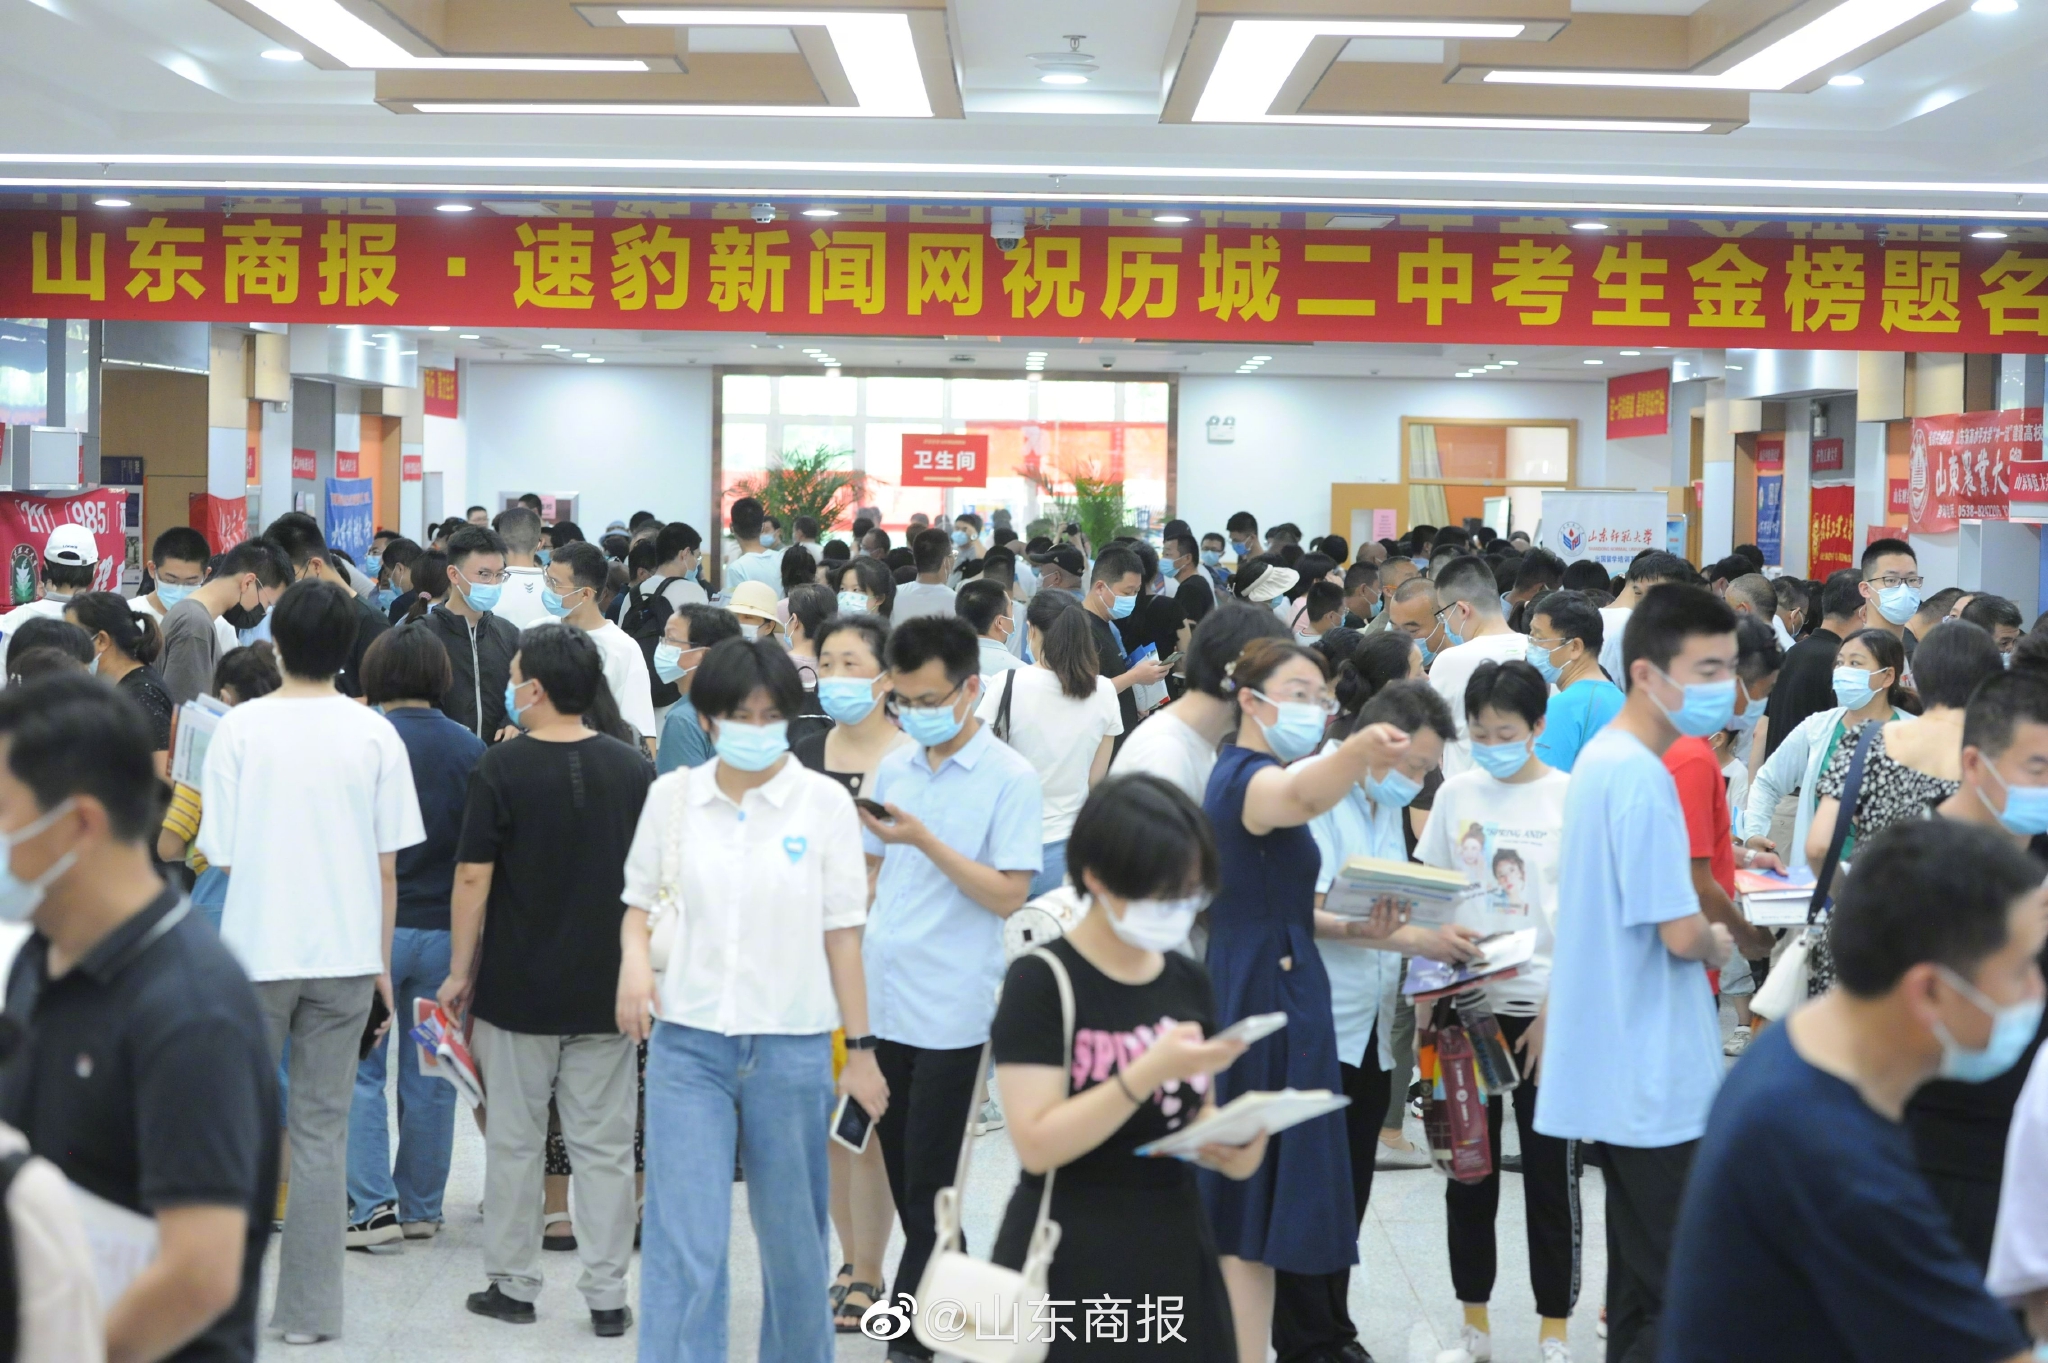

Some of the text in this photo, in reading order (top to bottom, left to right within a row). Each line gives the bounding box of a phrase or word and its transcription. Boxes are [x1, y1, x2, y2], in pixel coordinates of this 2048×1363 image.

[913, 450, 976, 471] 卫生间
[1588, 527, 1653, 545] 山东师范大学
